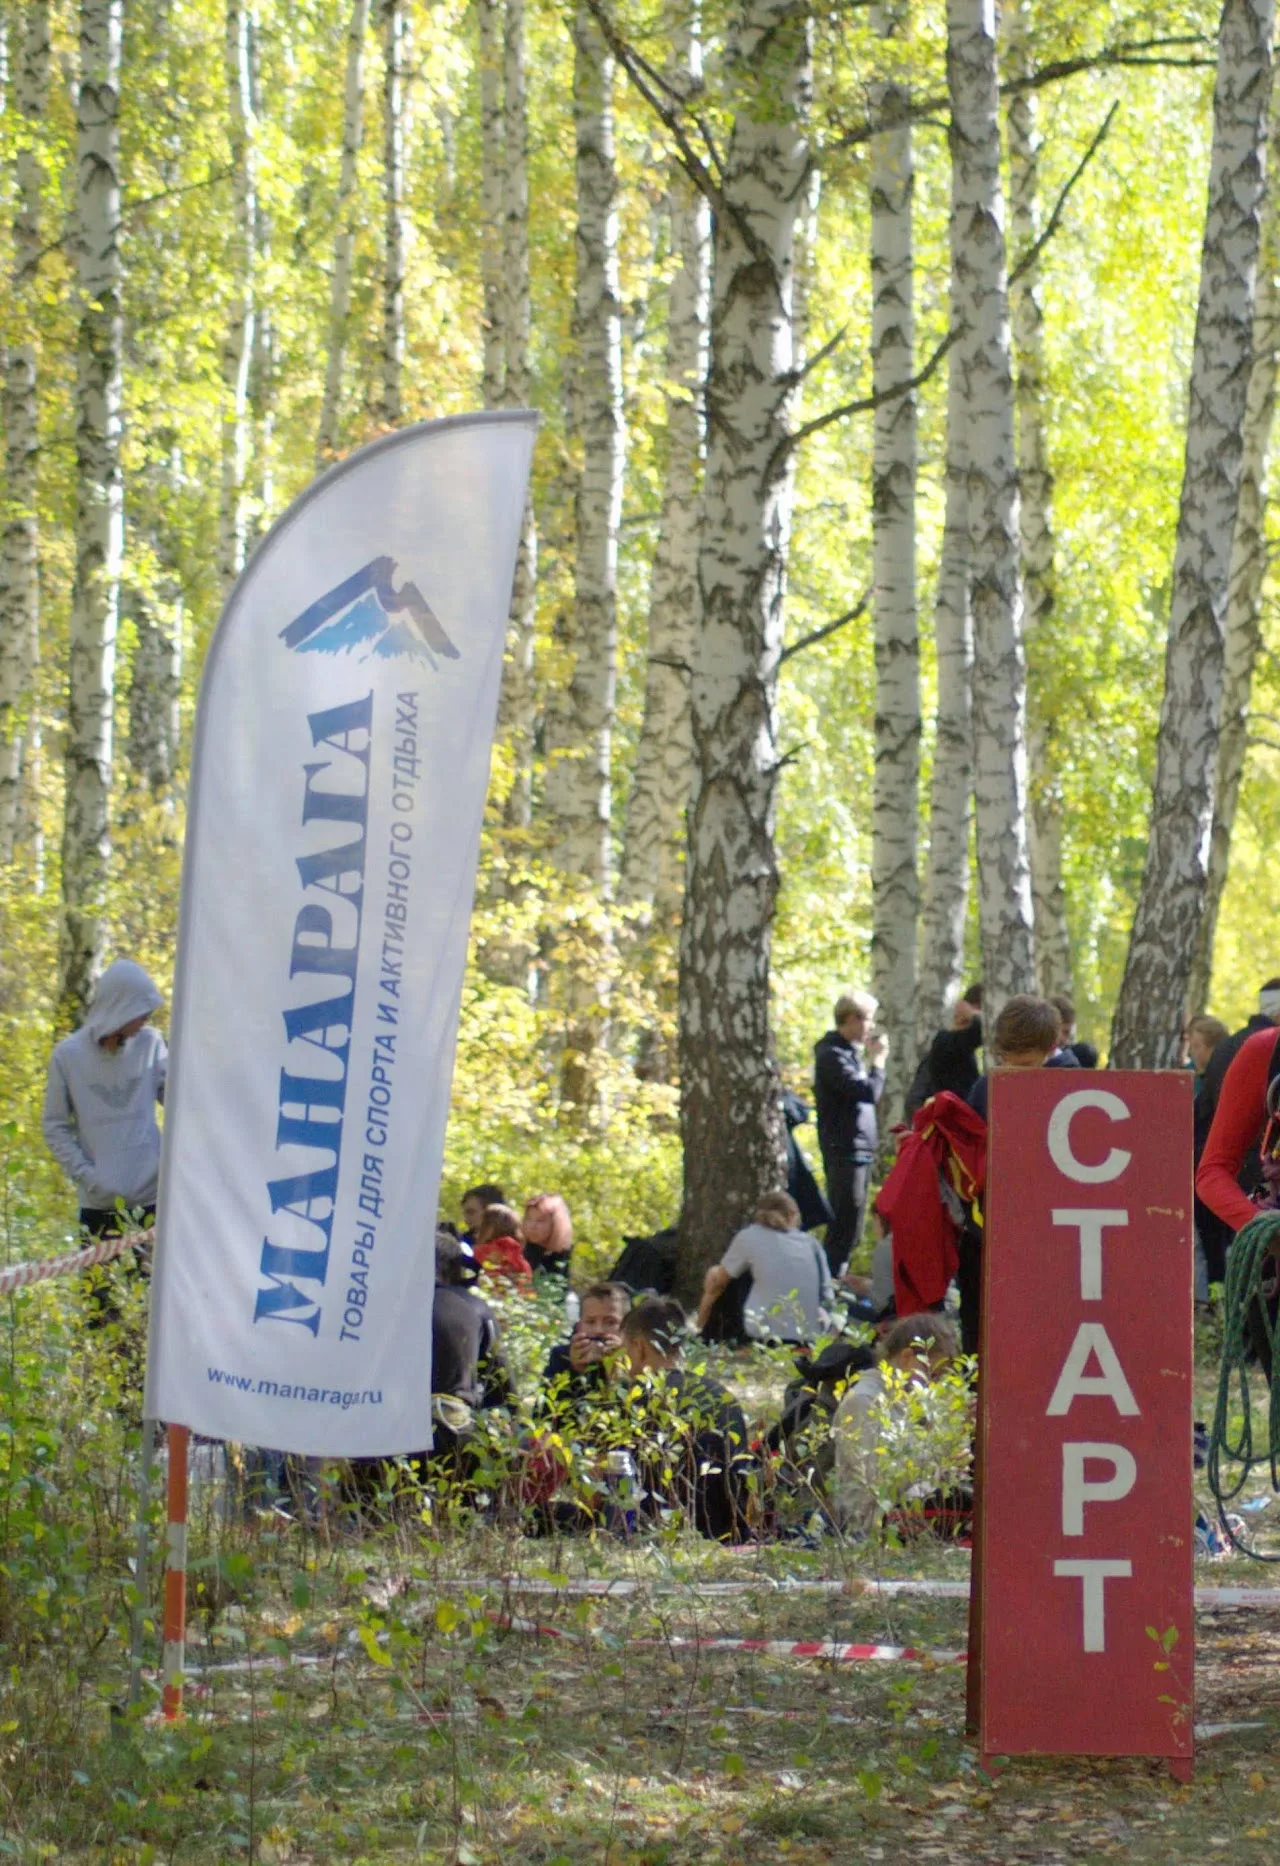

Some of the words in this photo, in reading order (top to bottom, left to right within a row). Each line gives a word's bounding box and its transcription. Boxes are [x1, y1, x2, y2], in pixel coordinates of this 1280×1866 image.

[391, 690, 422, 813] ОТДЫХА
[380, 822, 413, 998] АКТИВНОГО
[253, 688, 374, 1339] МАНАРАГА
[376, 1002, 399, 1025] И
[366, 1034, 397, 1146] СПОРТА
[359, 1154, 385, 1219] ДЛЯ
[340, 1220, 376, 1342] ТОВАРЫ
[1045, 1089, 1141, 1654] СТАРТ
